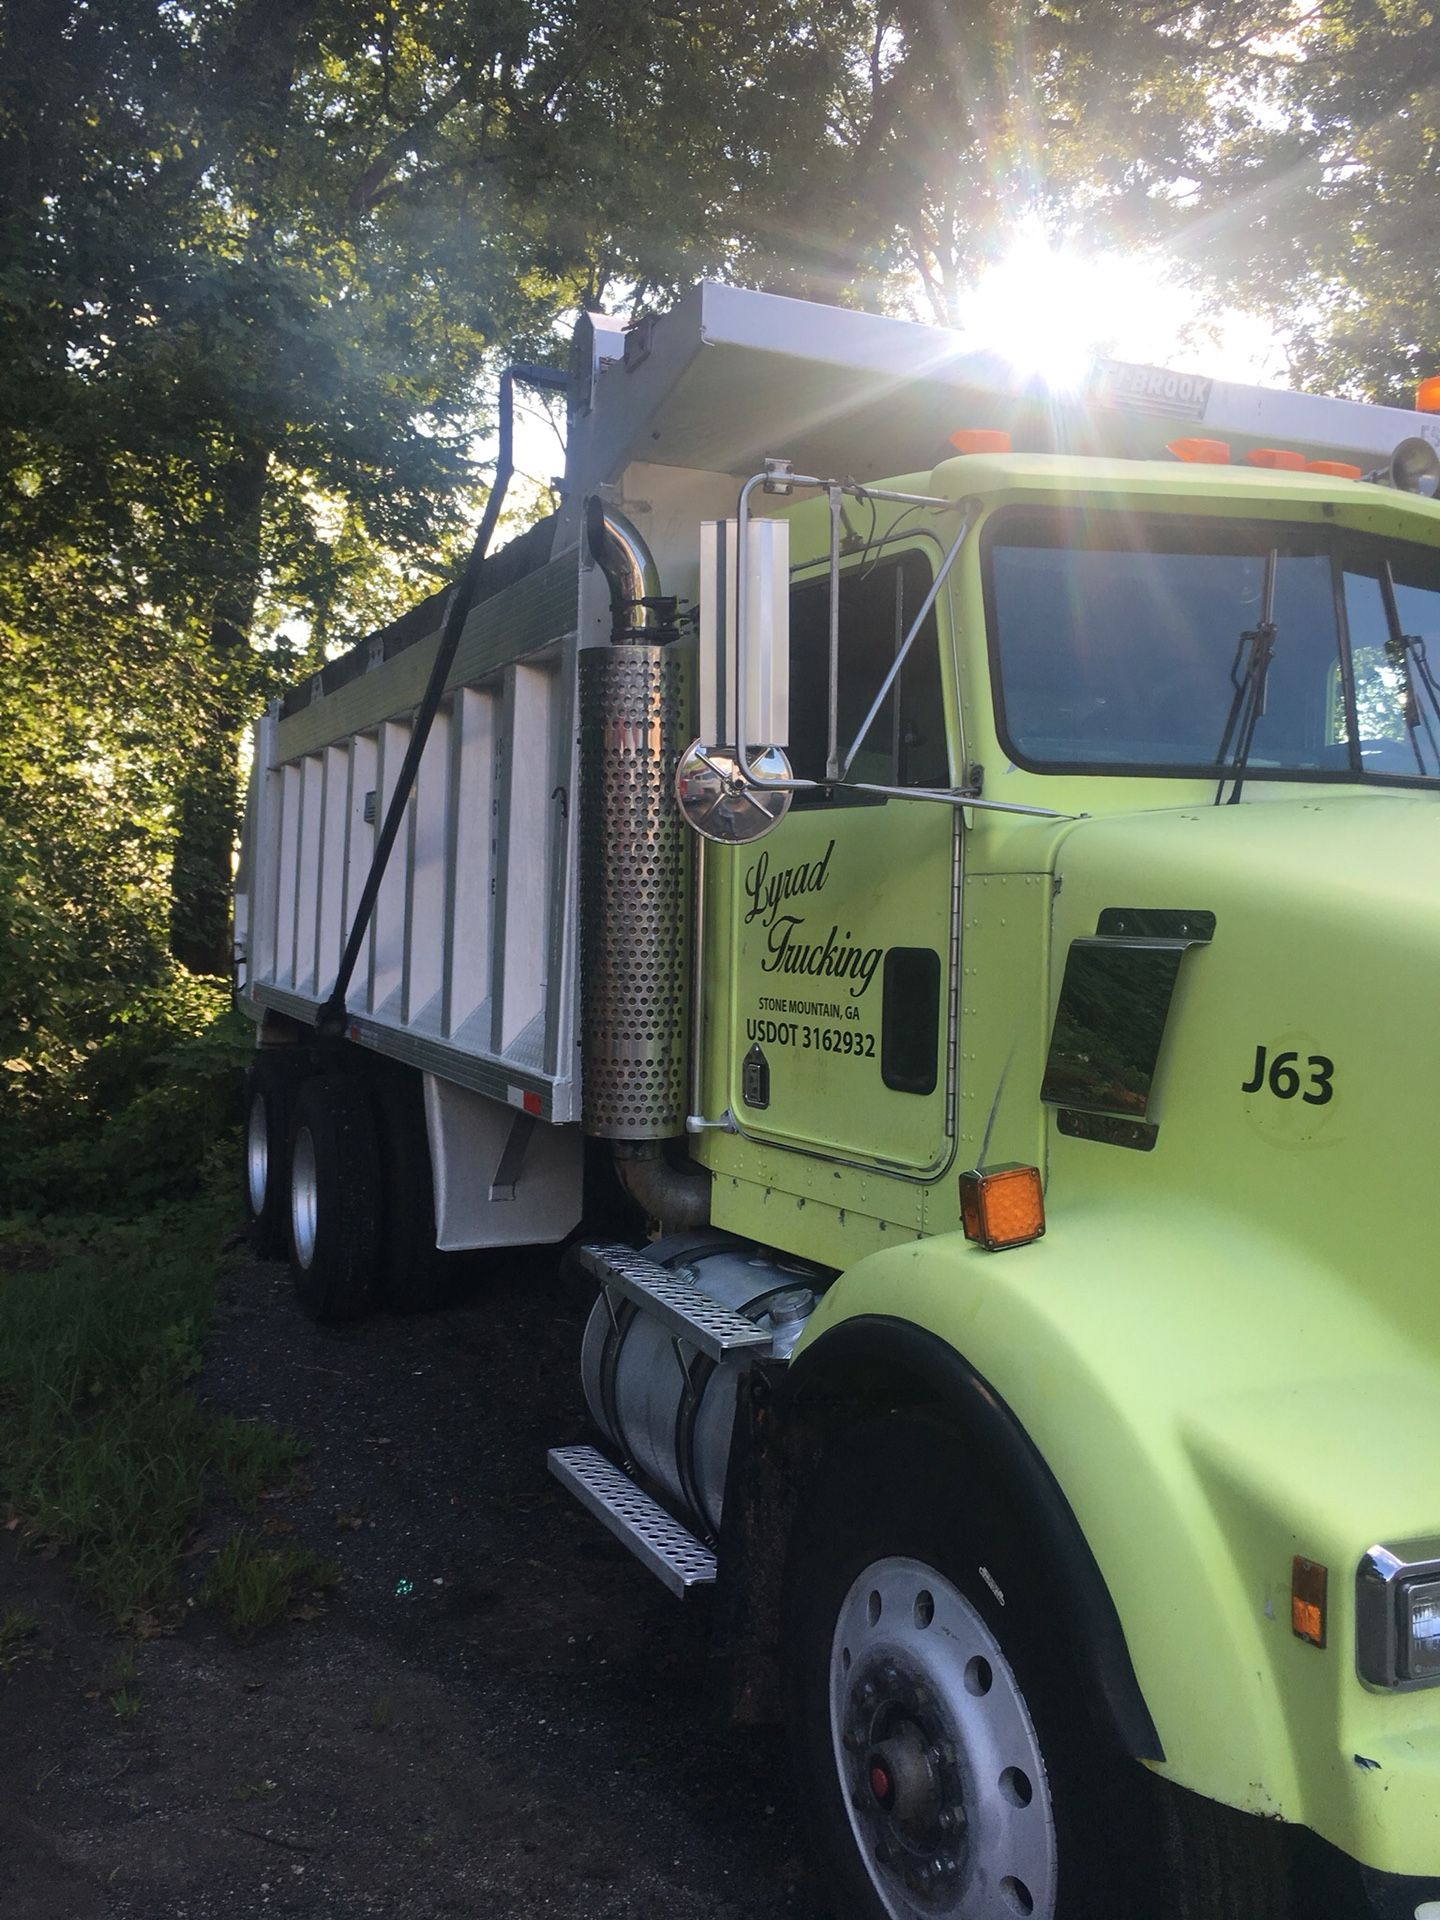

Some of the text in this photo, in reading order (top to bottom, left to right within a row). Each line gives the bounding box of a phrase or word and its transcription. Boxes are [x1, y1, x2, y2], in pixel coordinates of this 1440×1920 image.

[744, 840, 836, 927] Lyrad
[761, 915, 883, 997] Trucking
[746, 1018, 876, 1058] USDOT 3162932
[758, 997, 860, 1021] STONE MOUNTAIN, GA
[1241, 1045, 1335, 1106] J63
